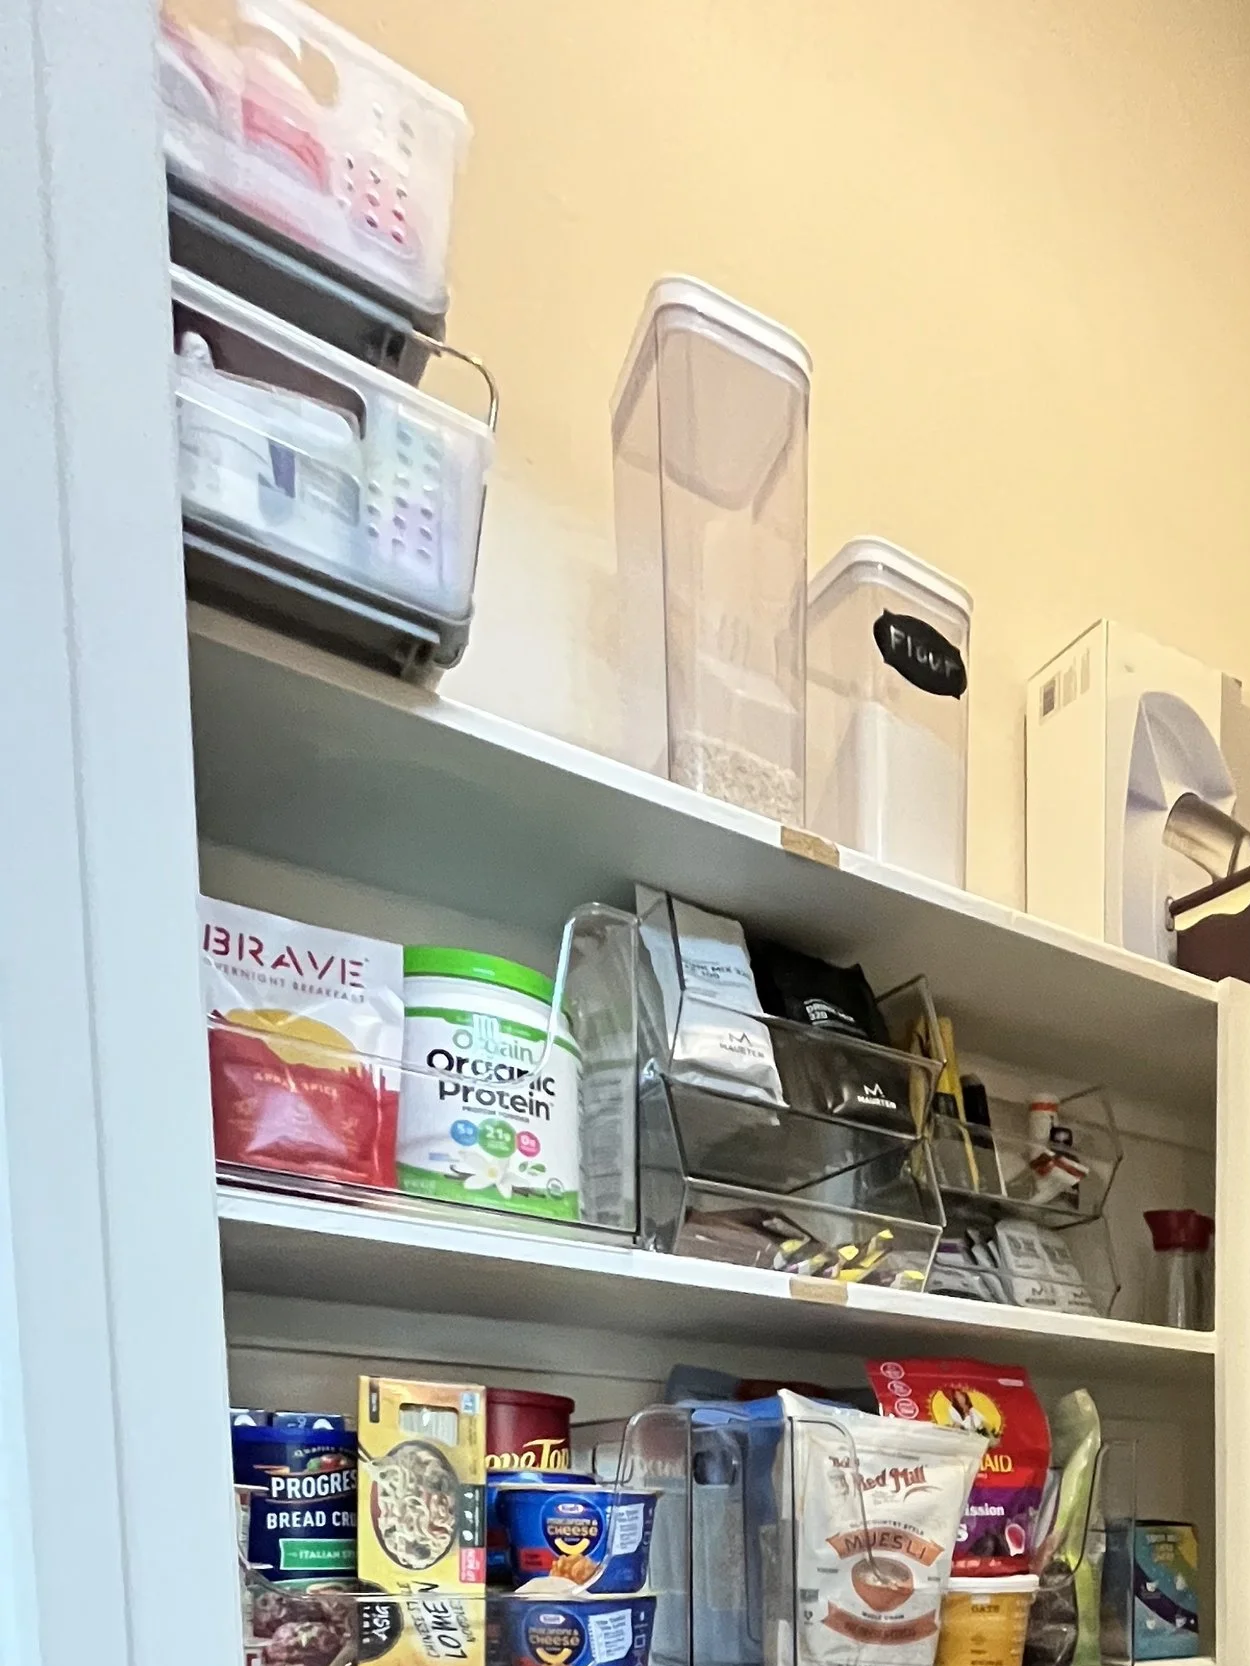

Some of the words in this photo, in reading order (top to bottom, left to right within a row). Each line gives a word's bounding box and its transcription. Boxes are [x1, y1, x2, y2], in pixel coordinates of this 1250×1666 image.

[889, 624, 960, 679] Flour
[203, 923, 366, 989] BRAVE
[426, 1049, 556, 1096] Organic
[438, 1079, 551, 1121] Protein
[889, 1464, 928, 1494] Mill
[266, 1510, 327, 1530] BREAD
[843, 1530, 926, 1561] MUESLI
